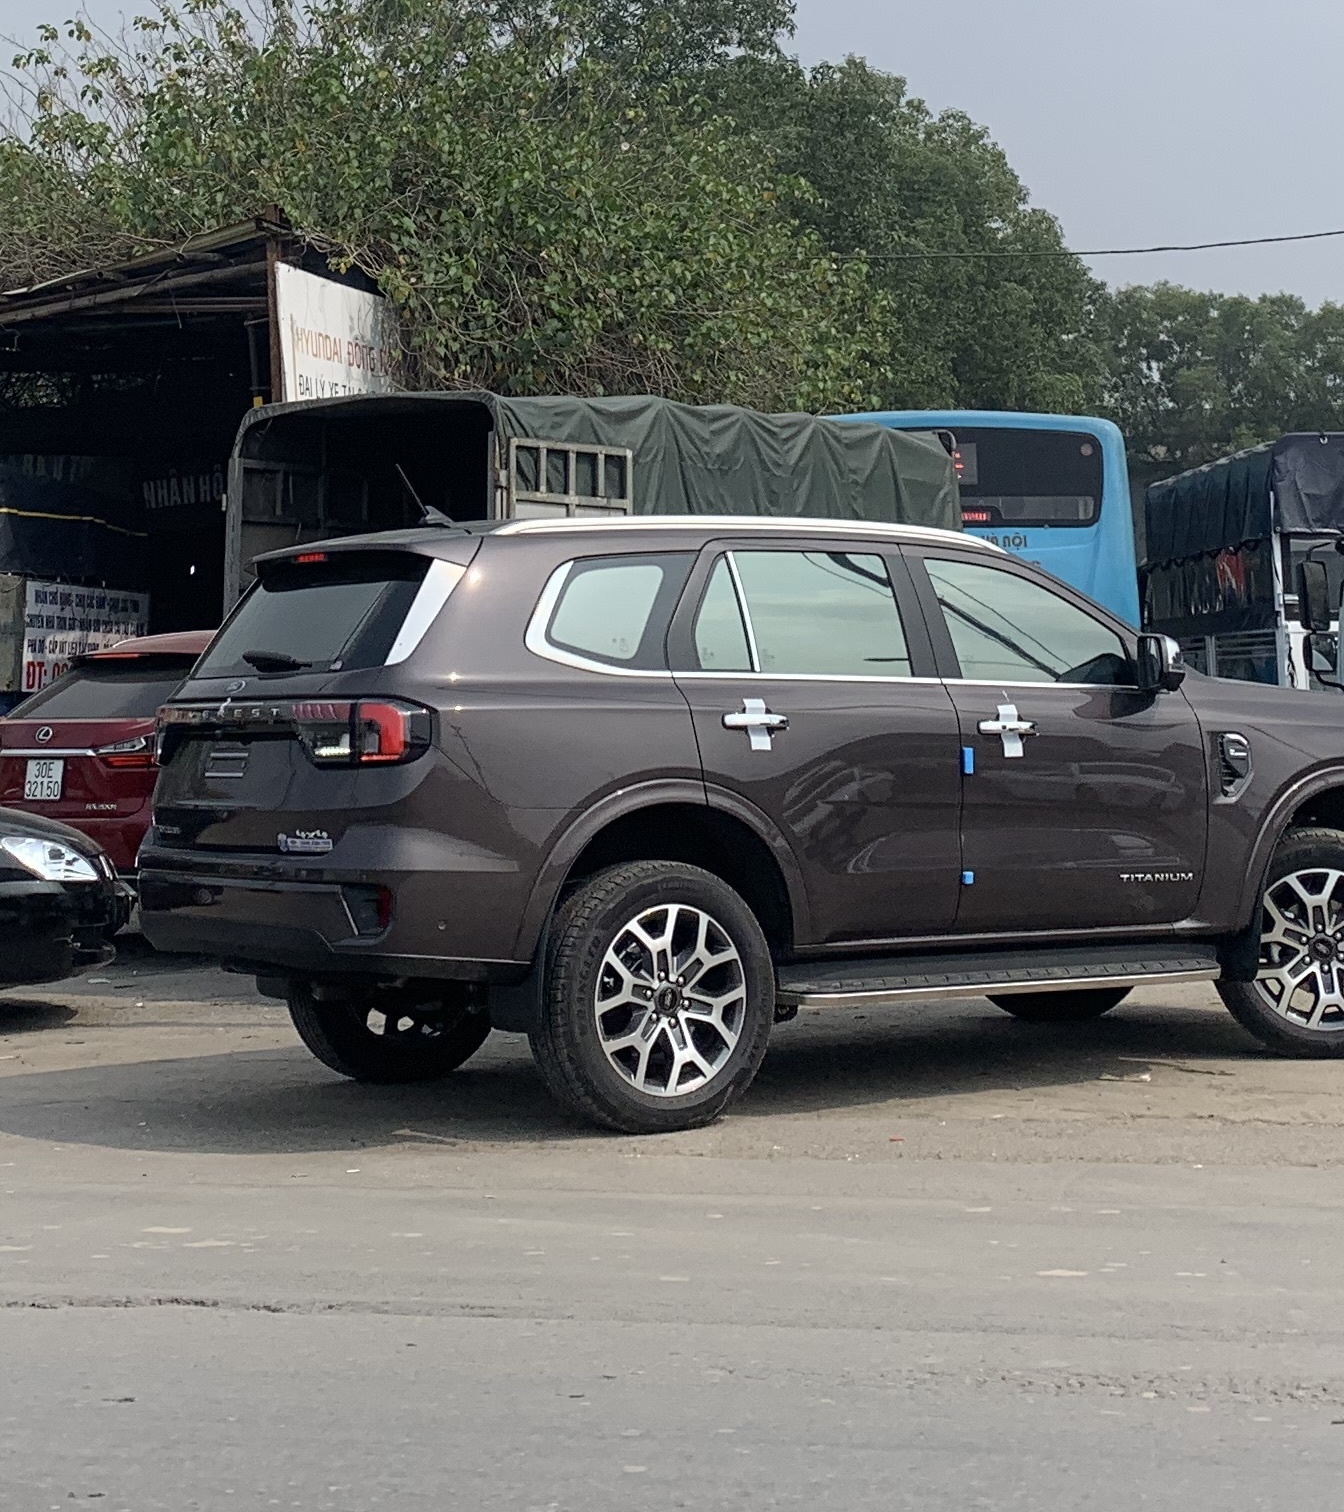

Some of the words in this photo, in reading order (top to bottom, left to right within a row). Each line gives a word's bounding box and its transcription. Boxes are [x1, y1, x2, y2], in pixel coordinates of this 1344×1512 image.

[296, 326, 342, 364] HYUNDAI
[34, 762, 53, 778] 30E
[1120, 872, 1194, 884] TITANIUM
